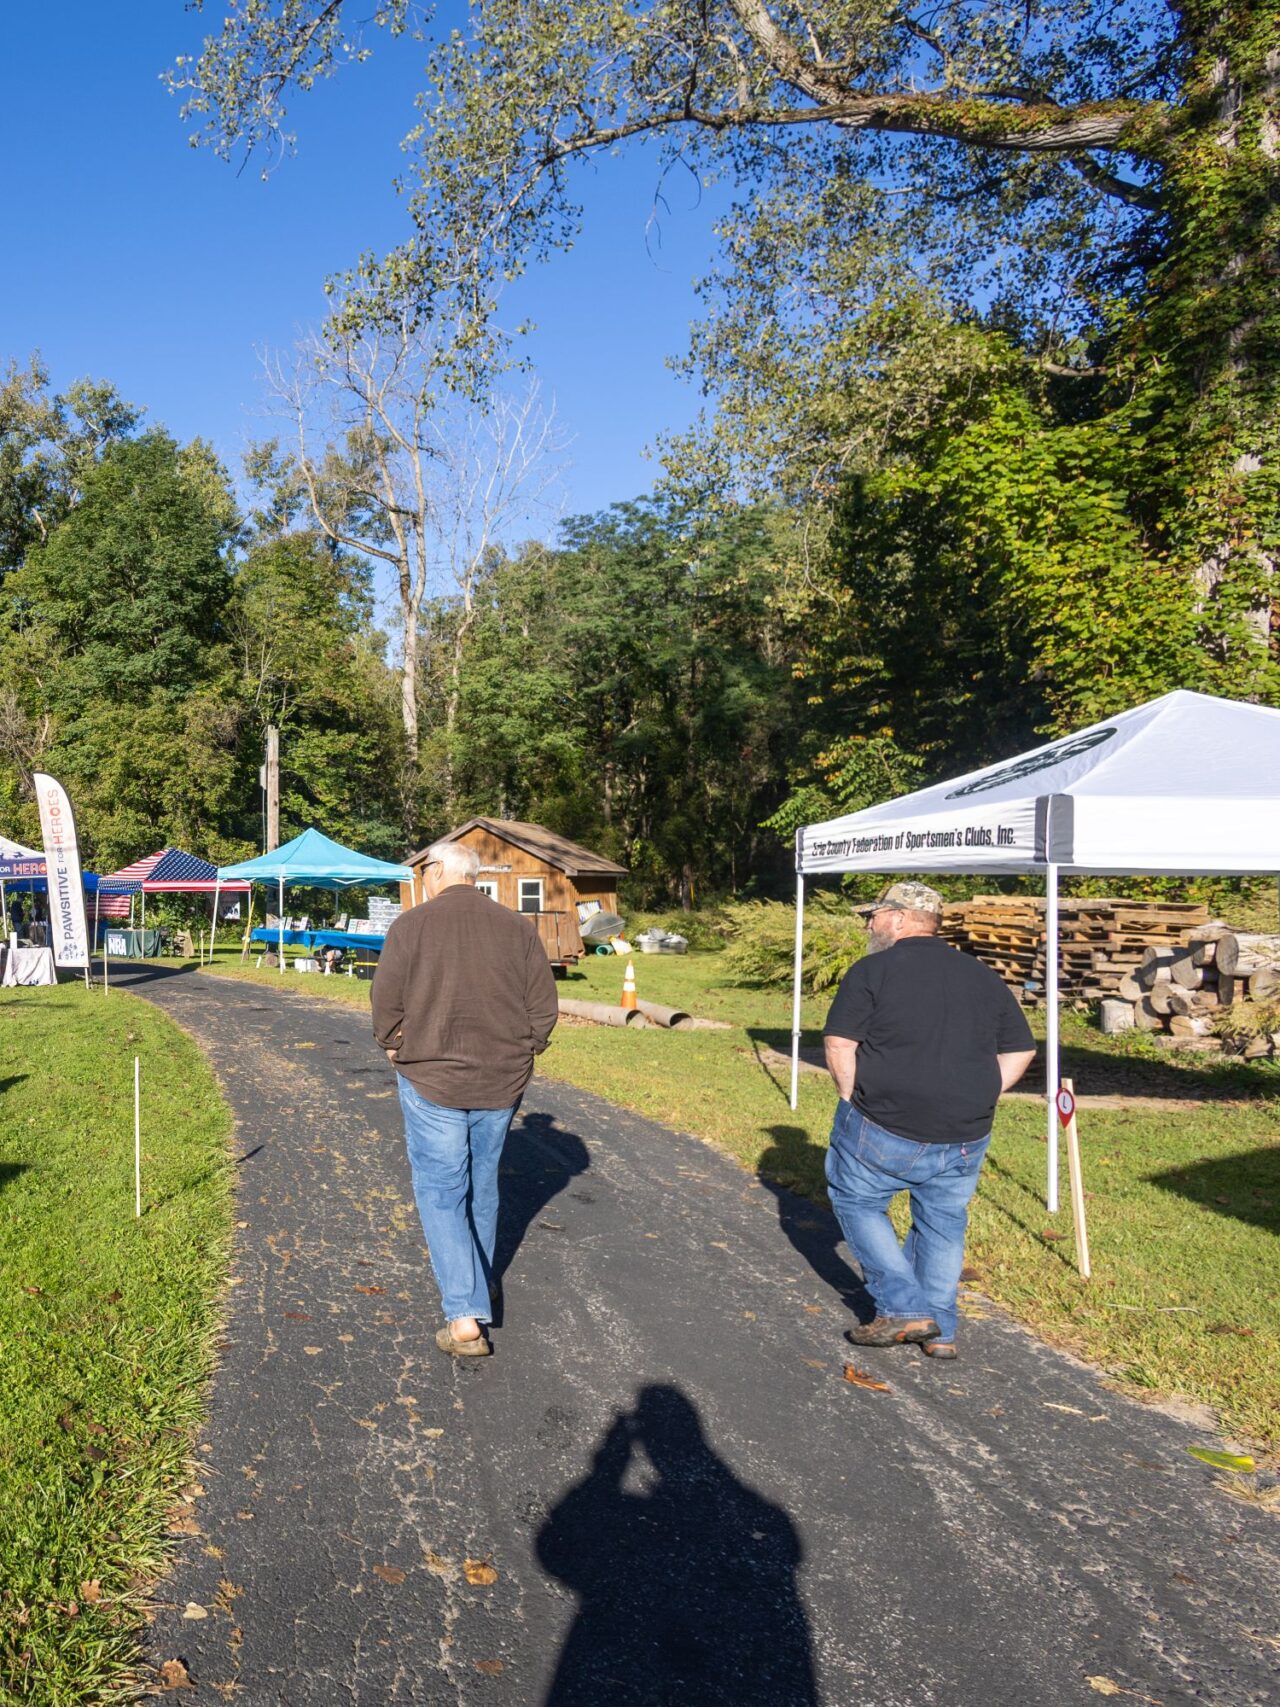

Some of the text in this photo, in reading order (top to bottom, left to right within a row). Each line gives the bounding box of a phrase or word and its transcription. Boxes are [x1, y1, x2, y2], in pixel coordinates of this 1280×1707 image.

[47, 789, 64, 845] HEROES
[812, 842, 826, 856] Erie
[827, 839, 851, 857] County
[851, 834, 893, 854] Federation
[895, 831, 905, 849] of
[906, 828, 962, 851] Sportsmen's
[997, 824, 1016, 845] Inc.
[13, 863, 48, 875] HERO
[56, 867, 74, 940] PAWSITIVE
[108, 938, 127, 956] NRA
